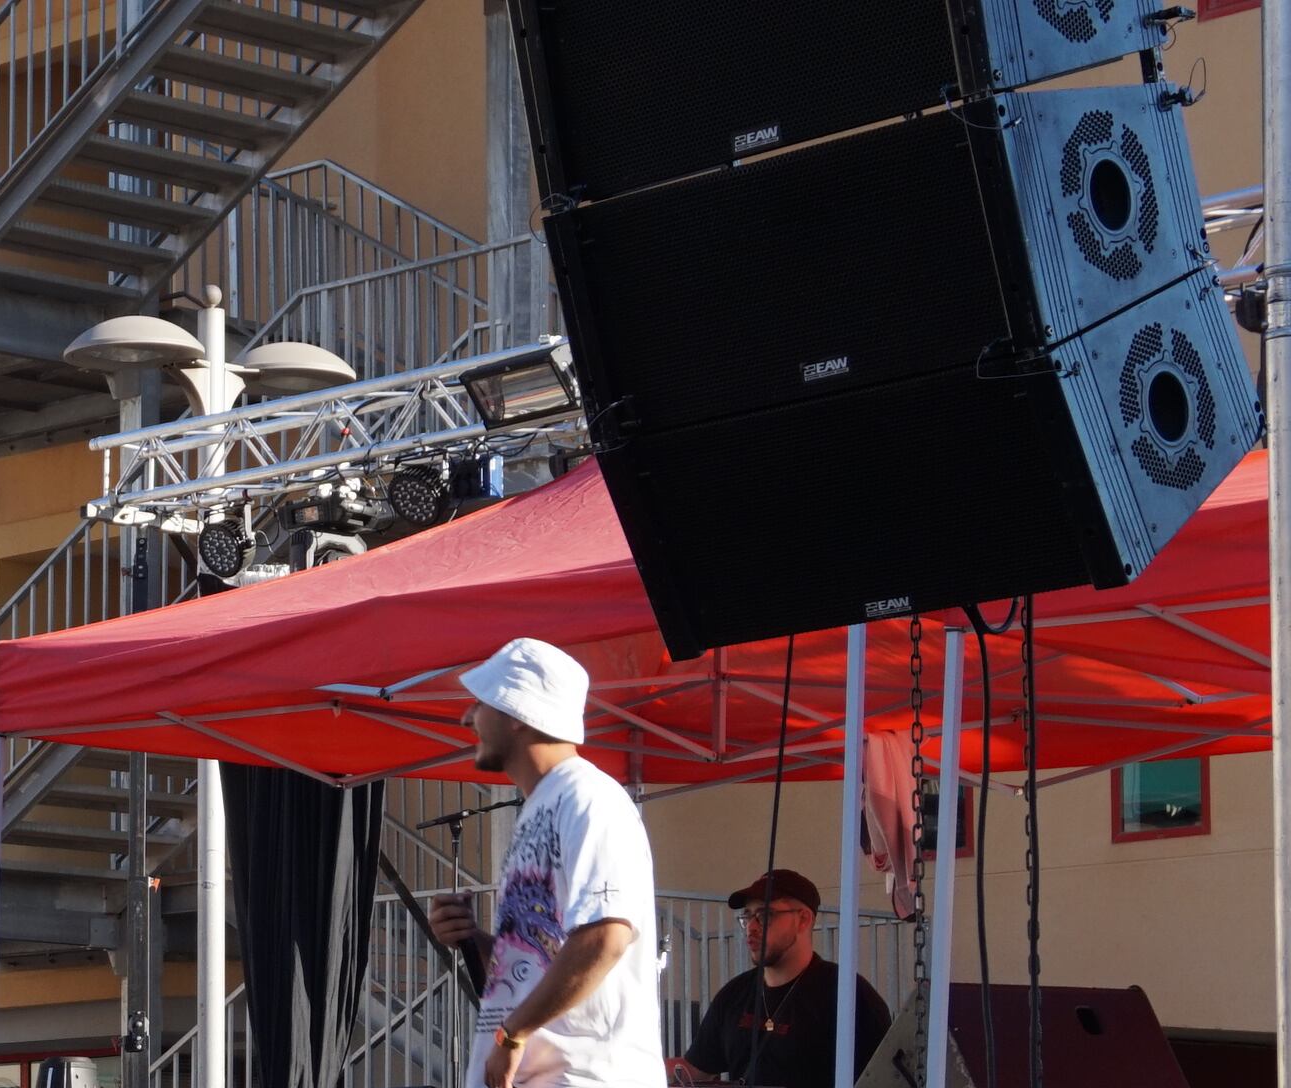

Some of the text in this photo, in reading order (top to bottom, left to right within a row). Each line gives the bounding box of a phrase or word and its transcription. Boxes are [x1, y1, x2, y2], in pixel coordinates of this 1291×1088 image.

[747, 126, 778, 144] EAW
[816, 356, 847, 373] EAW
[878, 596, 909, 610] EAW
